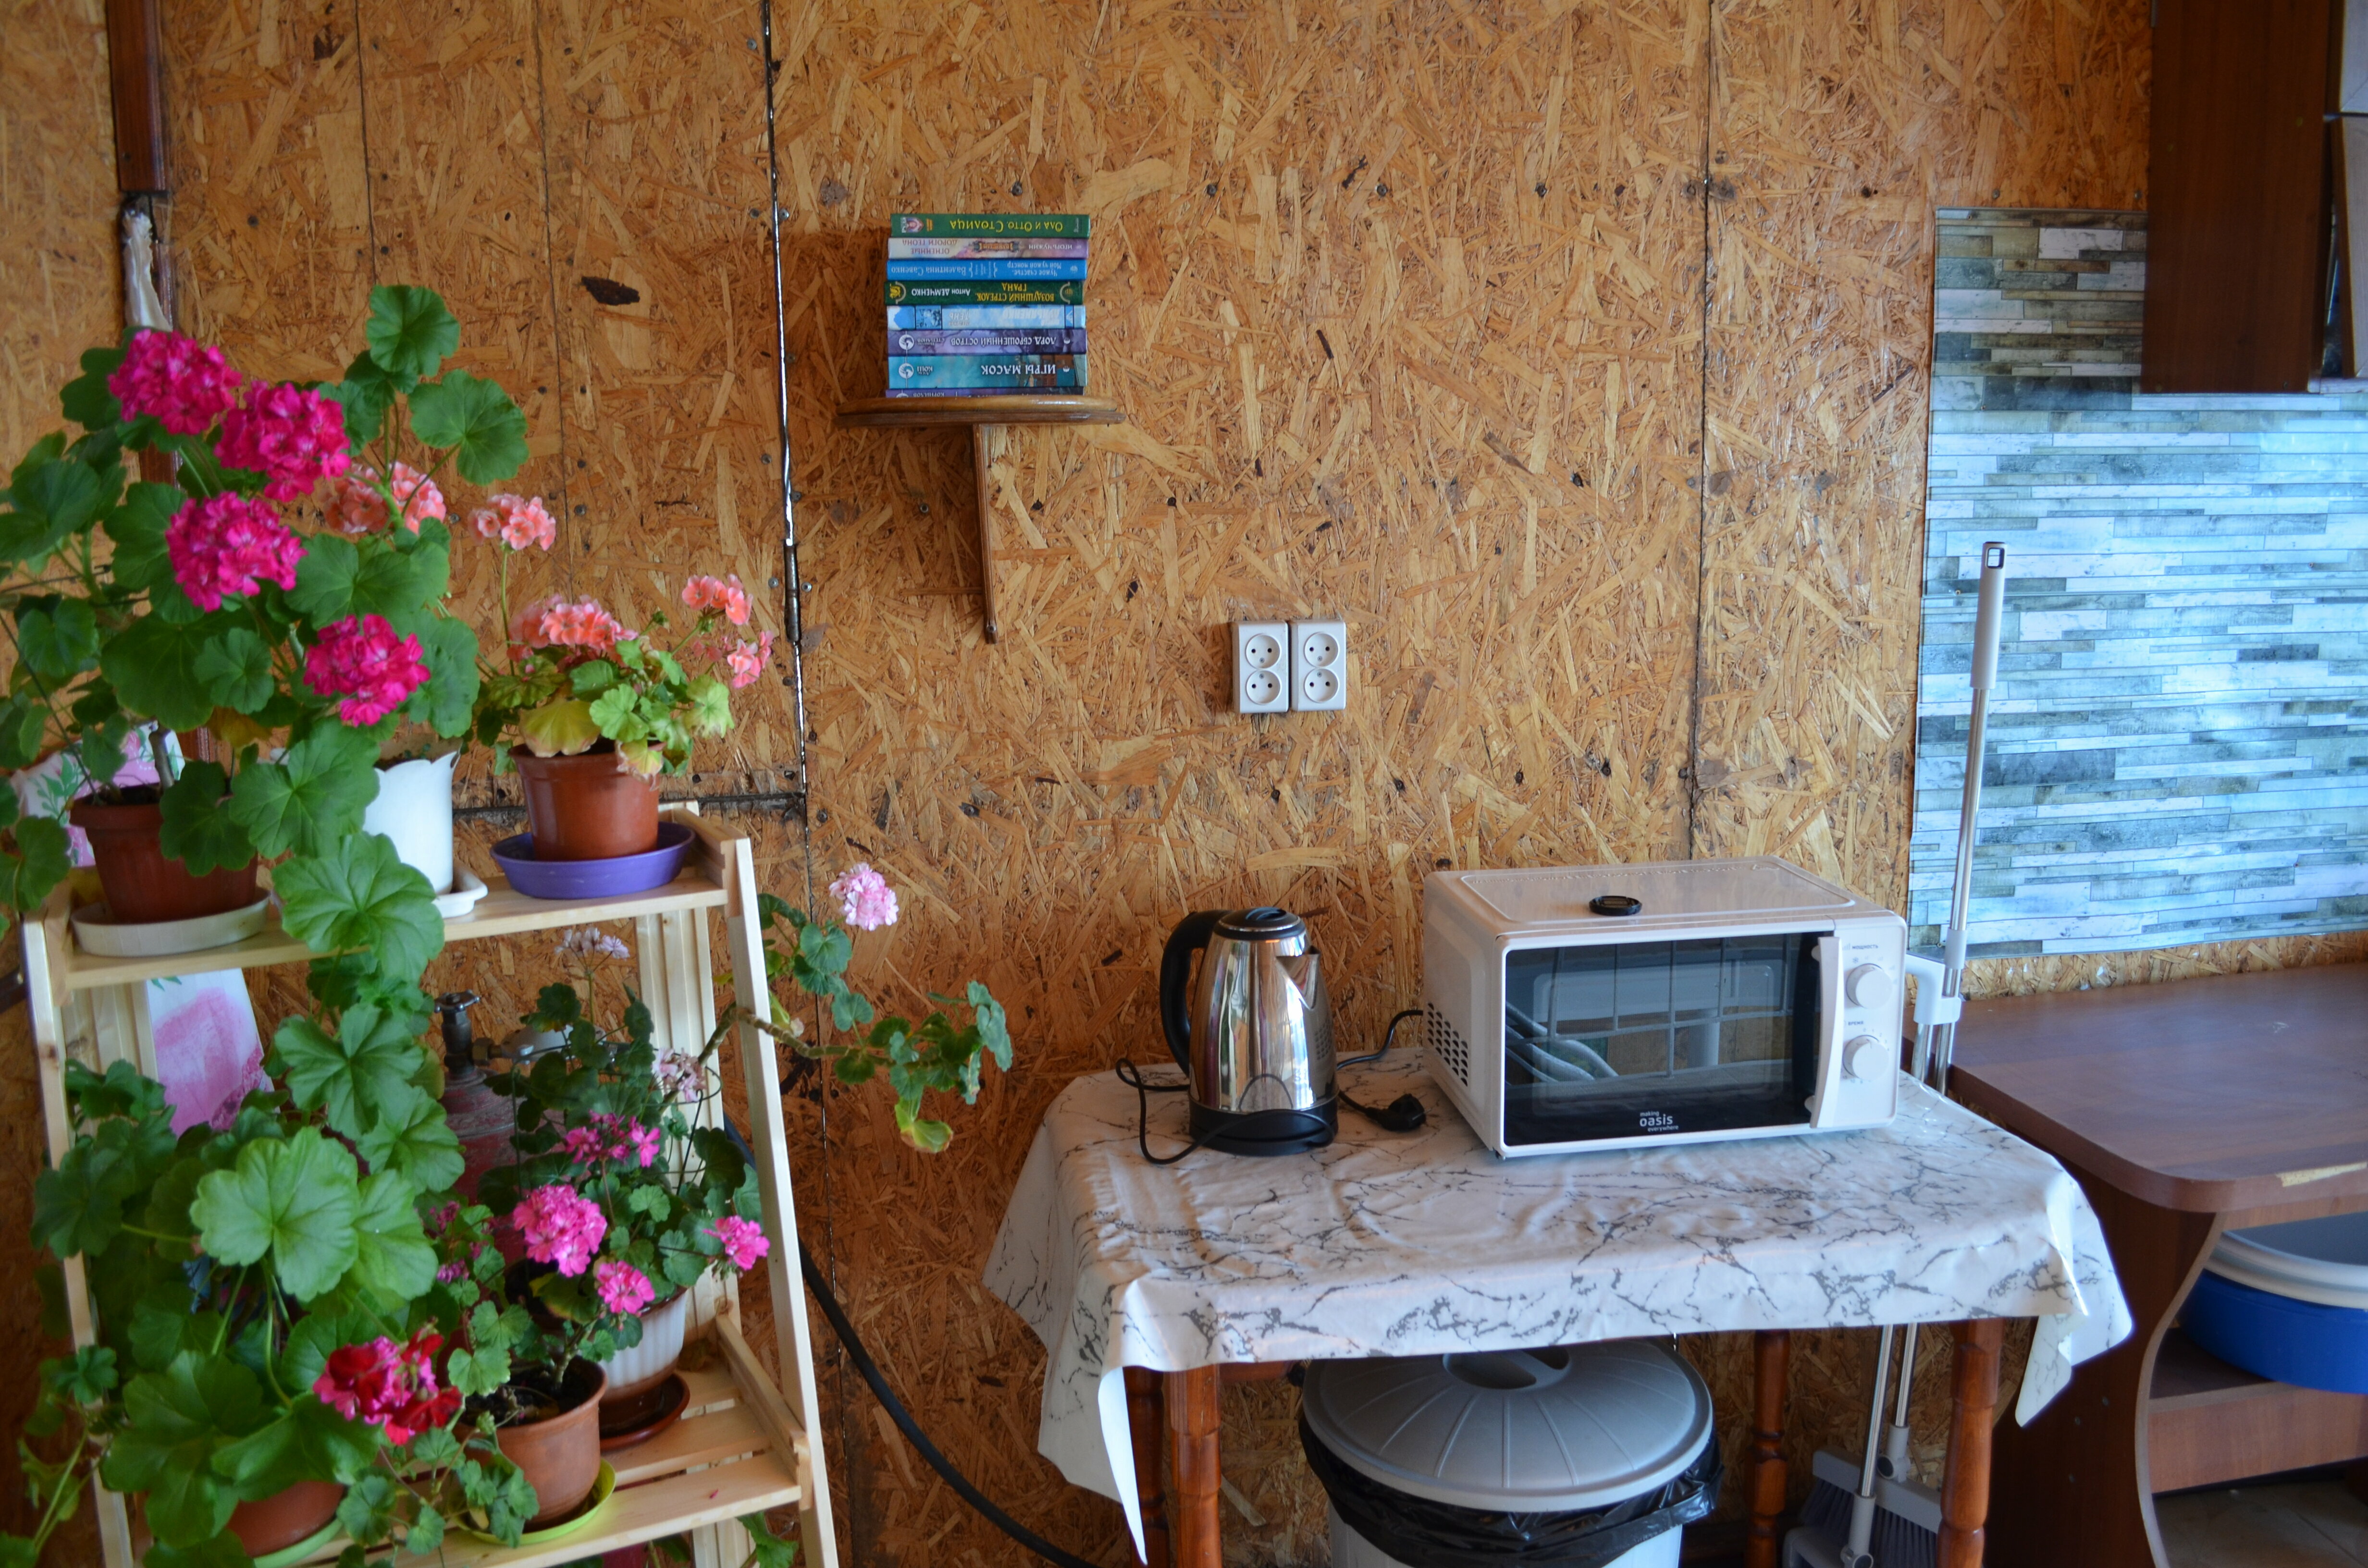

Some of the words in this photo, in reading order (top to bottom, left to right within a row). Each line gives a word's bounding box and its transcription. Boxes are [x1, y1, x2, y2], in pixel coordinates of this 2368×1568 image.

[950, 219, 1004, 233] Столица
[1007, 221, 1032, 232] Отто.
[1044, 221, 1063, 232] Ола
[891, 267, 924, 276] Савенко
[926, 267, 966, 276] Валентина
[1001, 282, 1026, 291] ГРАНД
[975, 293, 1007, 301] СТРЕЛОК.
[1010, 291, 1054, 303] ВОЗДУШНЫЙ
[981, 337, 1032, 346] СБРОШЕННЫЙ
[981, 365, 1021, 375] МАСОК
[1025, 364, 1056, 374] ИГРЫ
[1640, 1114, 1673, 1127] oasis
